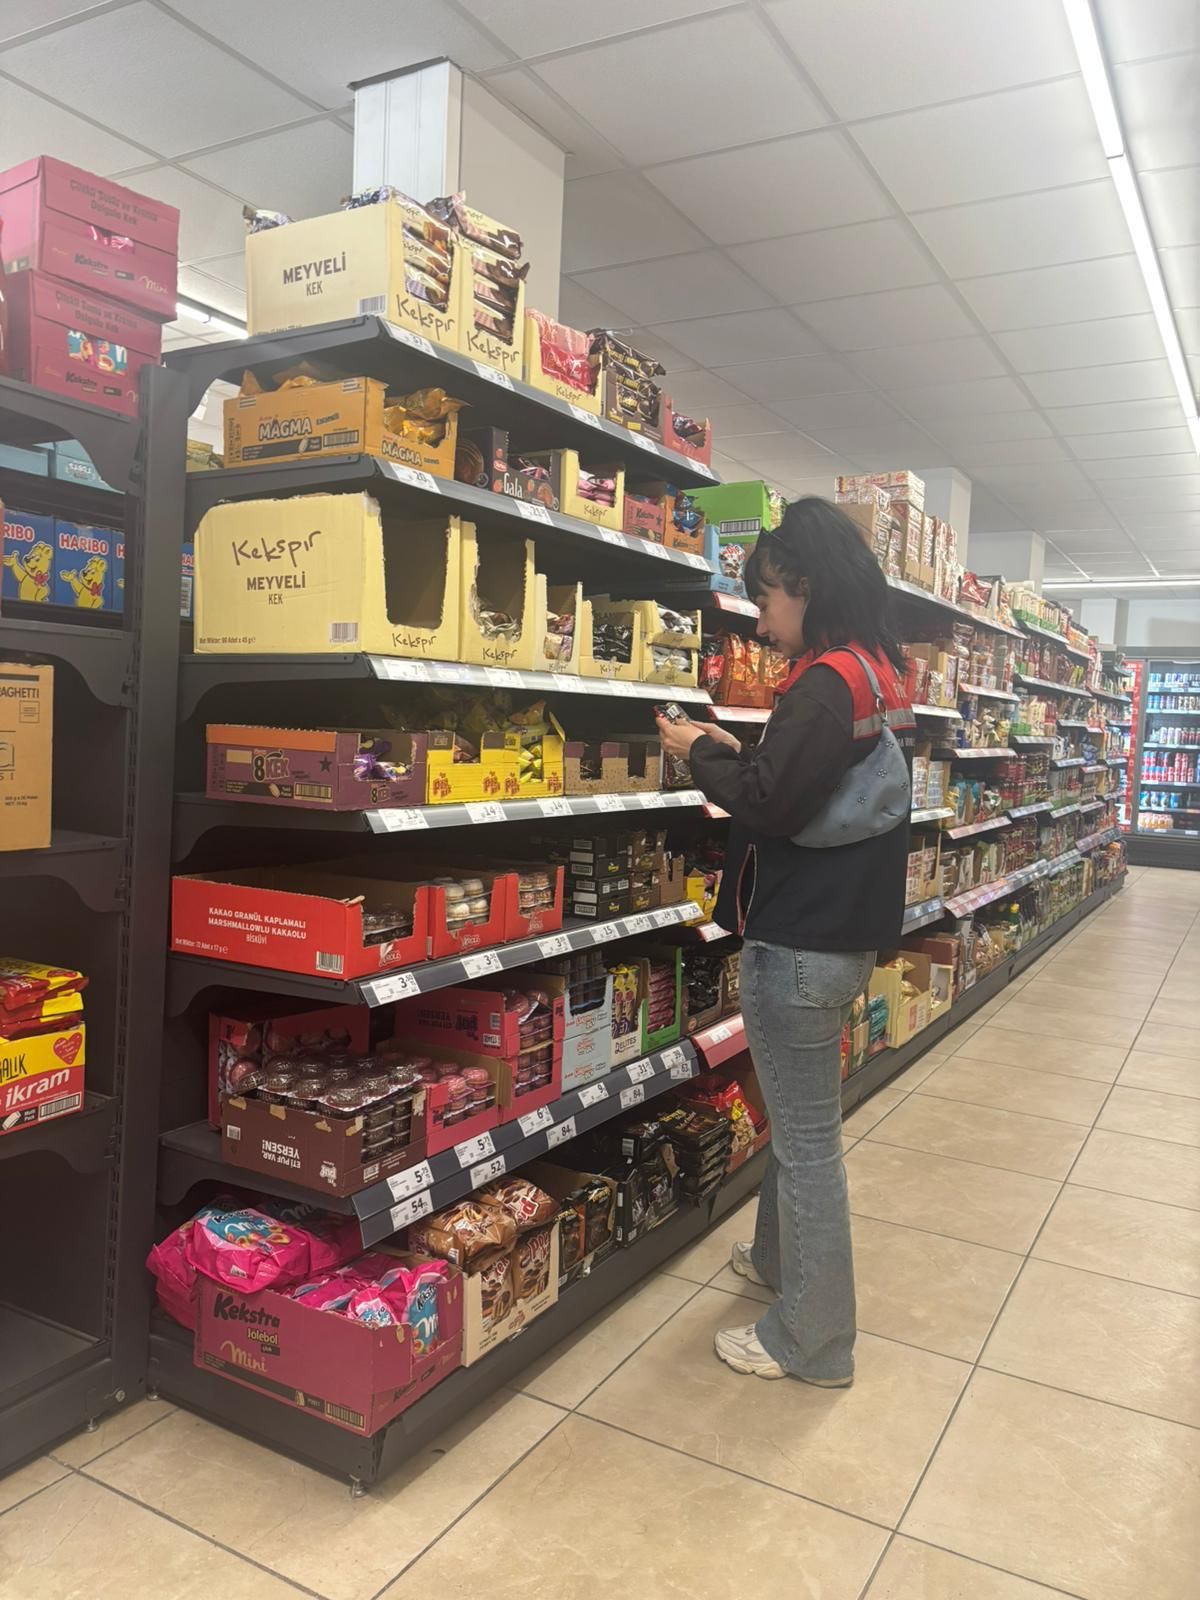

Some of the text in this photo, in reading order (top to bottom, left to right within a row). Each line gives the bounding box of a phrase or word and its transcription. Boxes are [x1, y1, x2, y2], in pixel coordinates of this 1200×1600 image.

[283, 251, 347, 285] MEYVELİ
[306, 281, 324, 297] KEK
[258, 414, 312, 442] MAGMA
[382, 440, 423, 467] MAGMA
[503, 472, 523, 499] Gala
[59, 532, 108, 556] HARIBO
[246, 570, 306, 591] MEYVELİ
[268, 593, 283, 605] KEK
[0, 686, 40, 699] AGHETTI
[208, 907, 306, 929] KAKAO GRANÜL KAPLAMALI
[208, 917, 307, 940] MARSHMALLOWLU KAKAOLU
[0, 1053, 28, 1084] ALIK
[5, 1068, 70, 1107] ikram
[262, 1139, 300, 1160] YERSEN!
[277, 1155, 290, 1165] PUF
[213, 1293, 281, 1329] Kekstra
[219, 1340, 268, 1373] Mini
